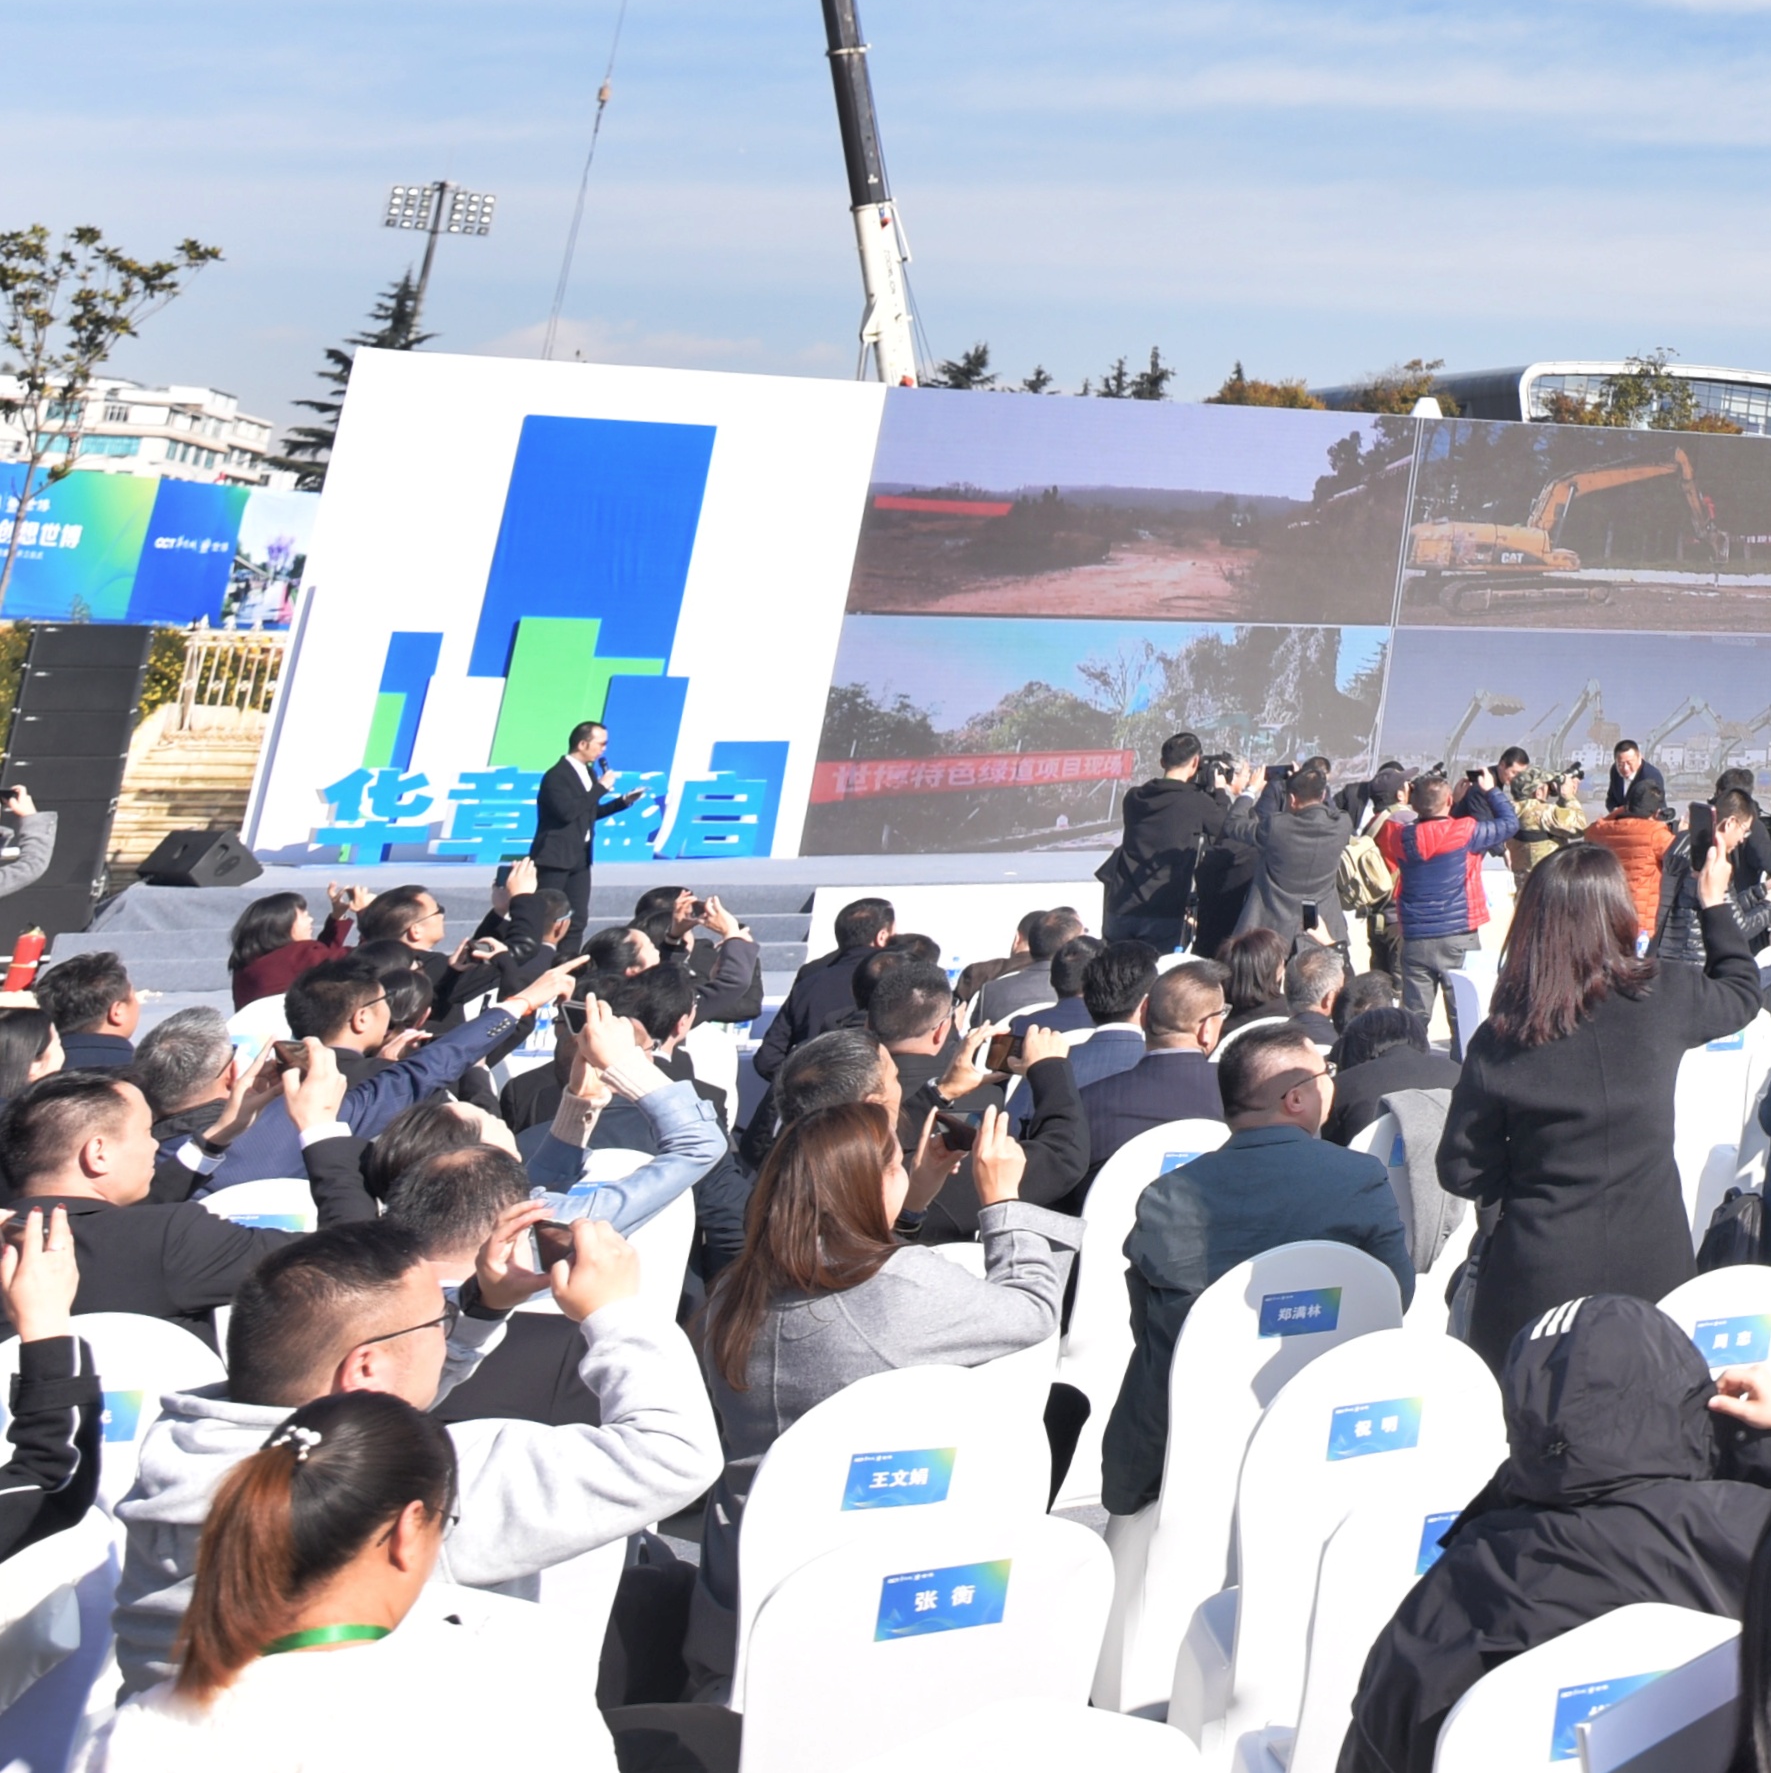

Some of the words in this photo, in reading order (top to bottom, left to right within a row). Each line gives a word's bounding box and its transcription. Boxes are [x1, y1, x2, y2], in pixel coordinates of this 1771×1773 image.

[1501, 552, 1525, 564] CAT
[832, 755, 1123, 794] 世博特色绿道项目现场
[312, 765, 768, 865] 华章盛启
[869, 1468, 930, 1489] 王文娟
